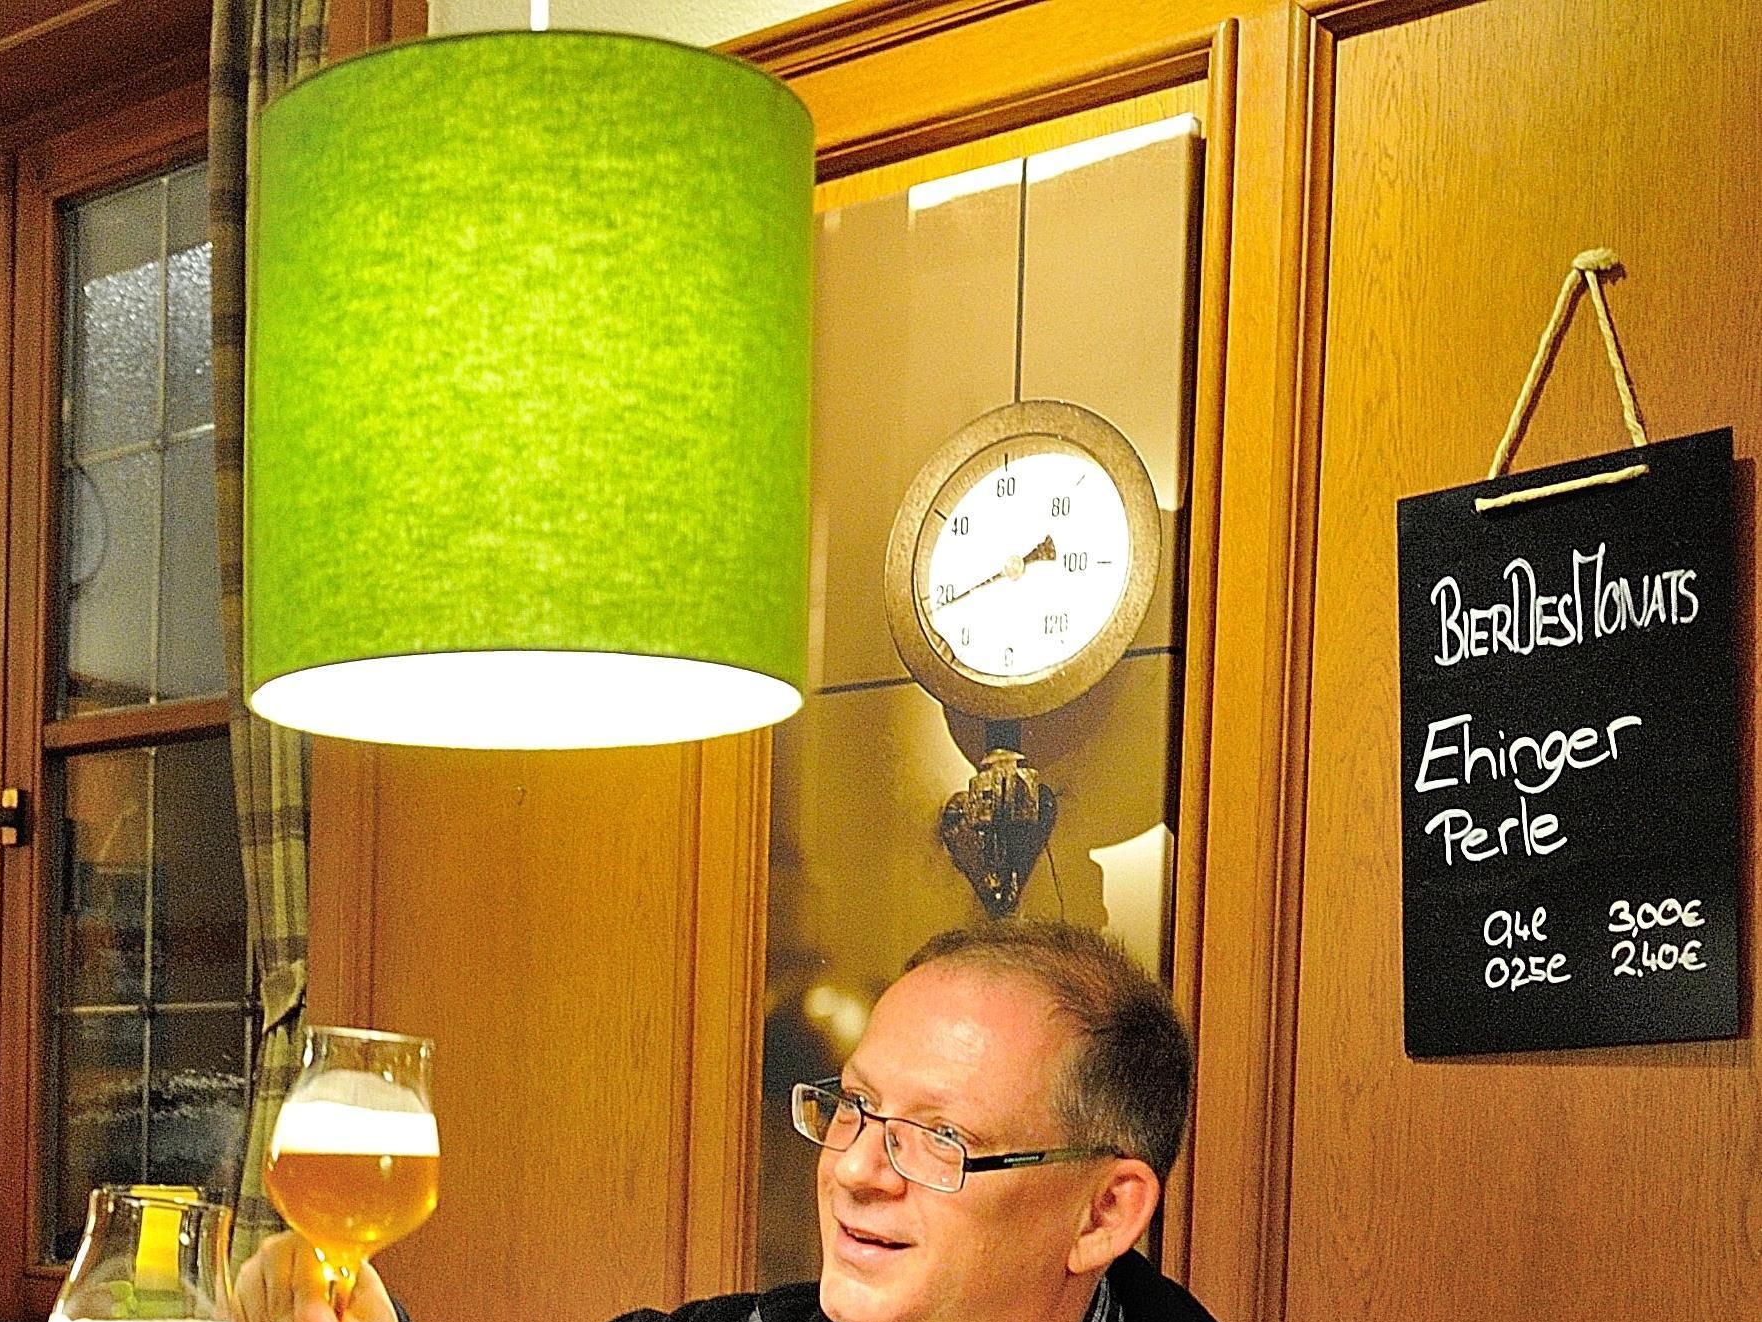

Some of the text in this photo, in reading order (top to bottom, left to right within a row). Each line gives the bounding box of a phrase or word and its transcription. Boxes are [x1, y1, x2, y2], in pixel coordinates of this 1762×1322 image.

[996, 476, 1017, 498] 60
[1051, 496, 1071, 517] 80
[951, 516, 970, 536] 40
[1063, 551, 1089, 573] 100
[936, 583, 955, 607] 20
[1414, 713, 1642, 794] Ehinger
[1424, 796, 1568, 866] Perle
[1608, 898, 1706, 938] 3,00€
